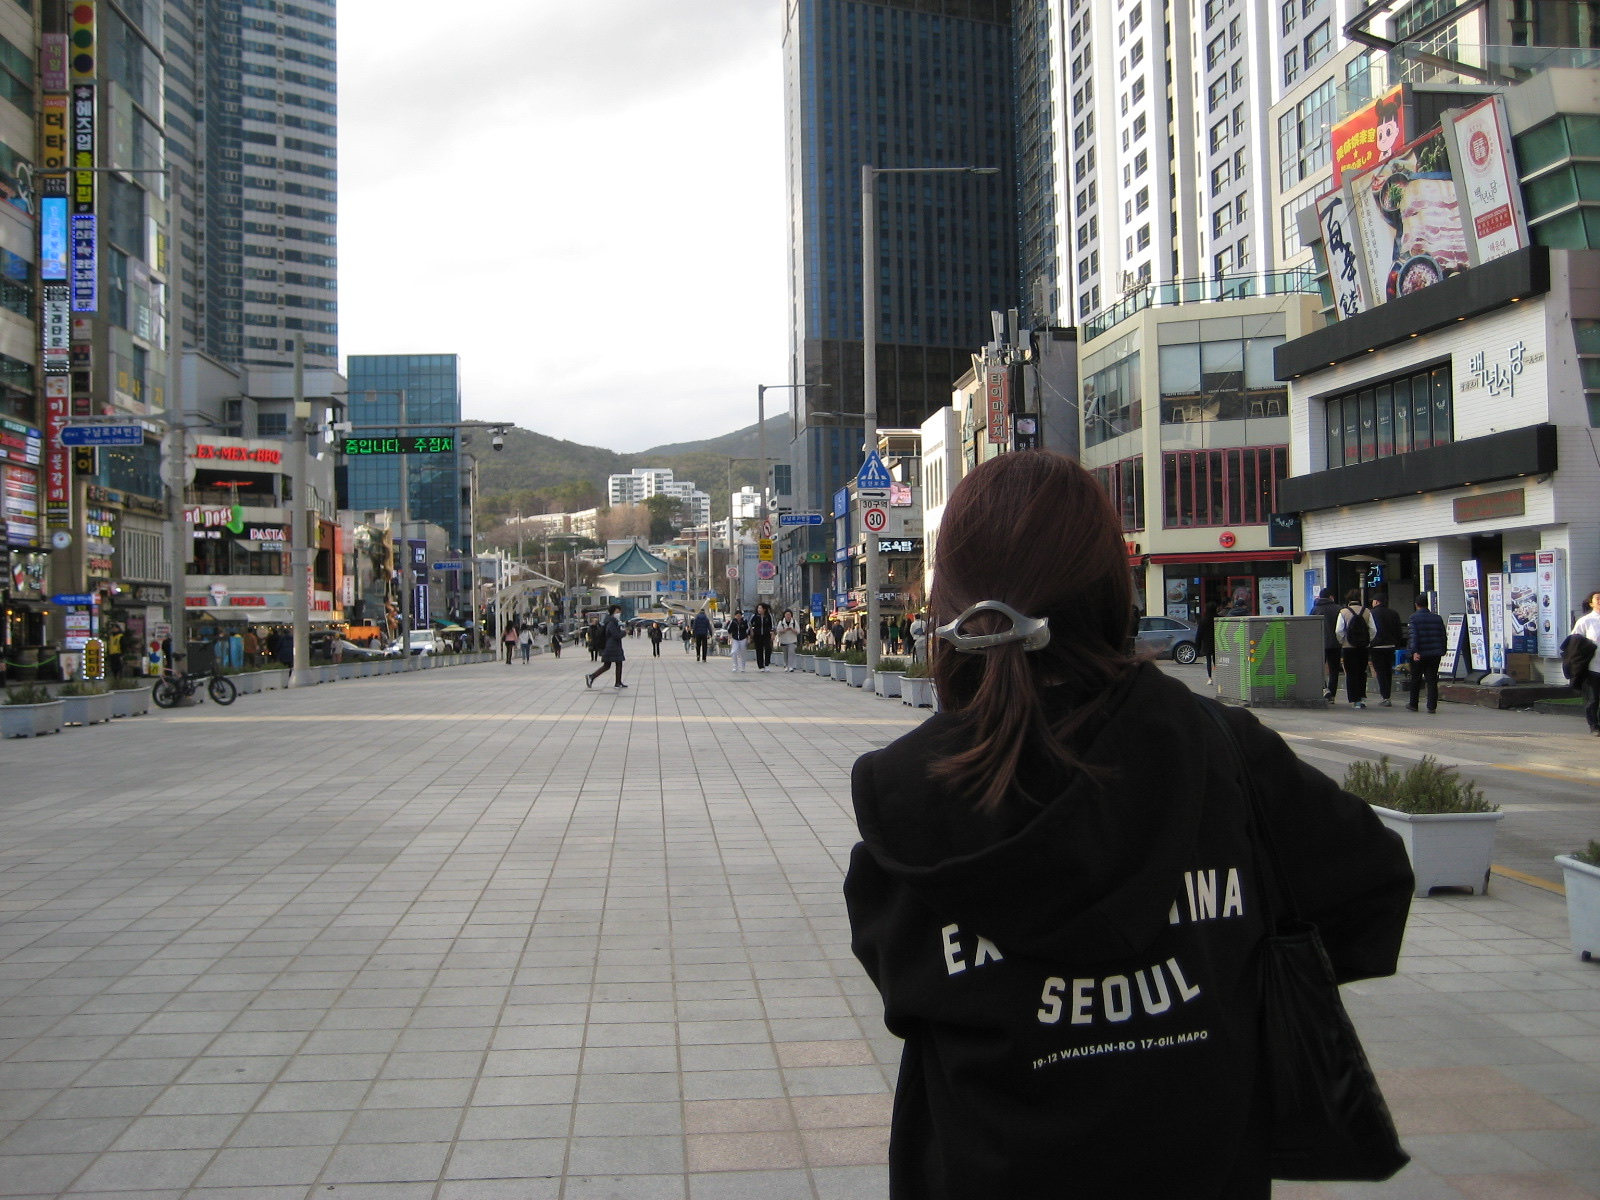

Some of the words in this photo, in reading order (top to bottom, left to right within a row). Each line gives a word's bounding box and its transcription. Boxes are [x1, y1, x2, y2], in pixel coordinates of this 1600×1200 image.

[46, 113, 66, 168] 더타이
[51, 302, 63, 347] 노래타운
[1469, 340, 1526, 398] 백년식당
[990, 373, 1005, 439] 타이마사지
[189, 444, 249, 461] EX-MEX
[256, 448, 282, 464] BBQ
[346, 439, 405, 455] 중입니다.
[250, 528, 286, 541] PASTA
[869, 514, 882, 526] 30
[230, 597, 267, 607] PIZZA
[1234, 617, 1296, 700] 14
[1037, 957, 1201, 1025] SEOUL
[1032, 1053, 1058, 1070] 19-12
[1060, 1040, 1136, 1060] WAUSAN-RO
[1140, 1038, 1175, 1049] 17-GIL
[1177, 1030, 1209, 1043] MAPO
